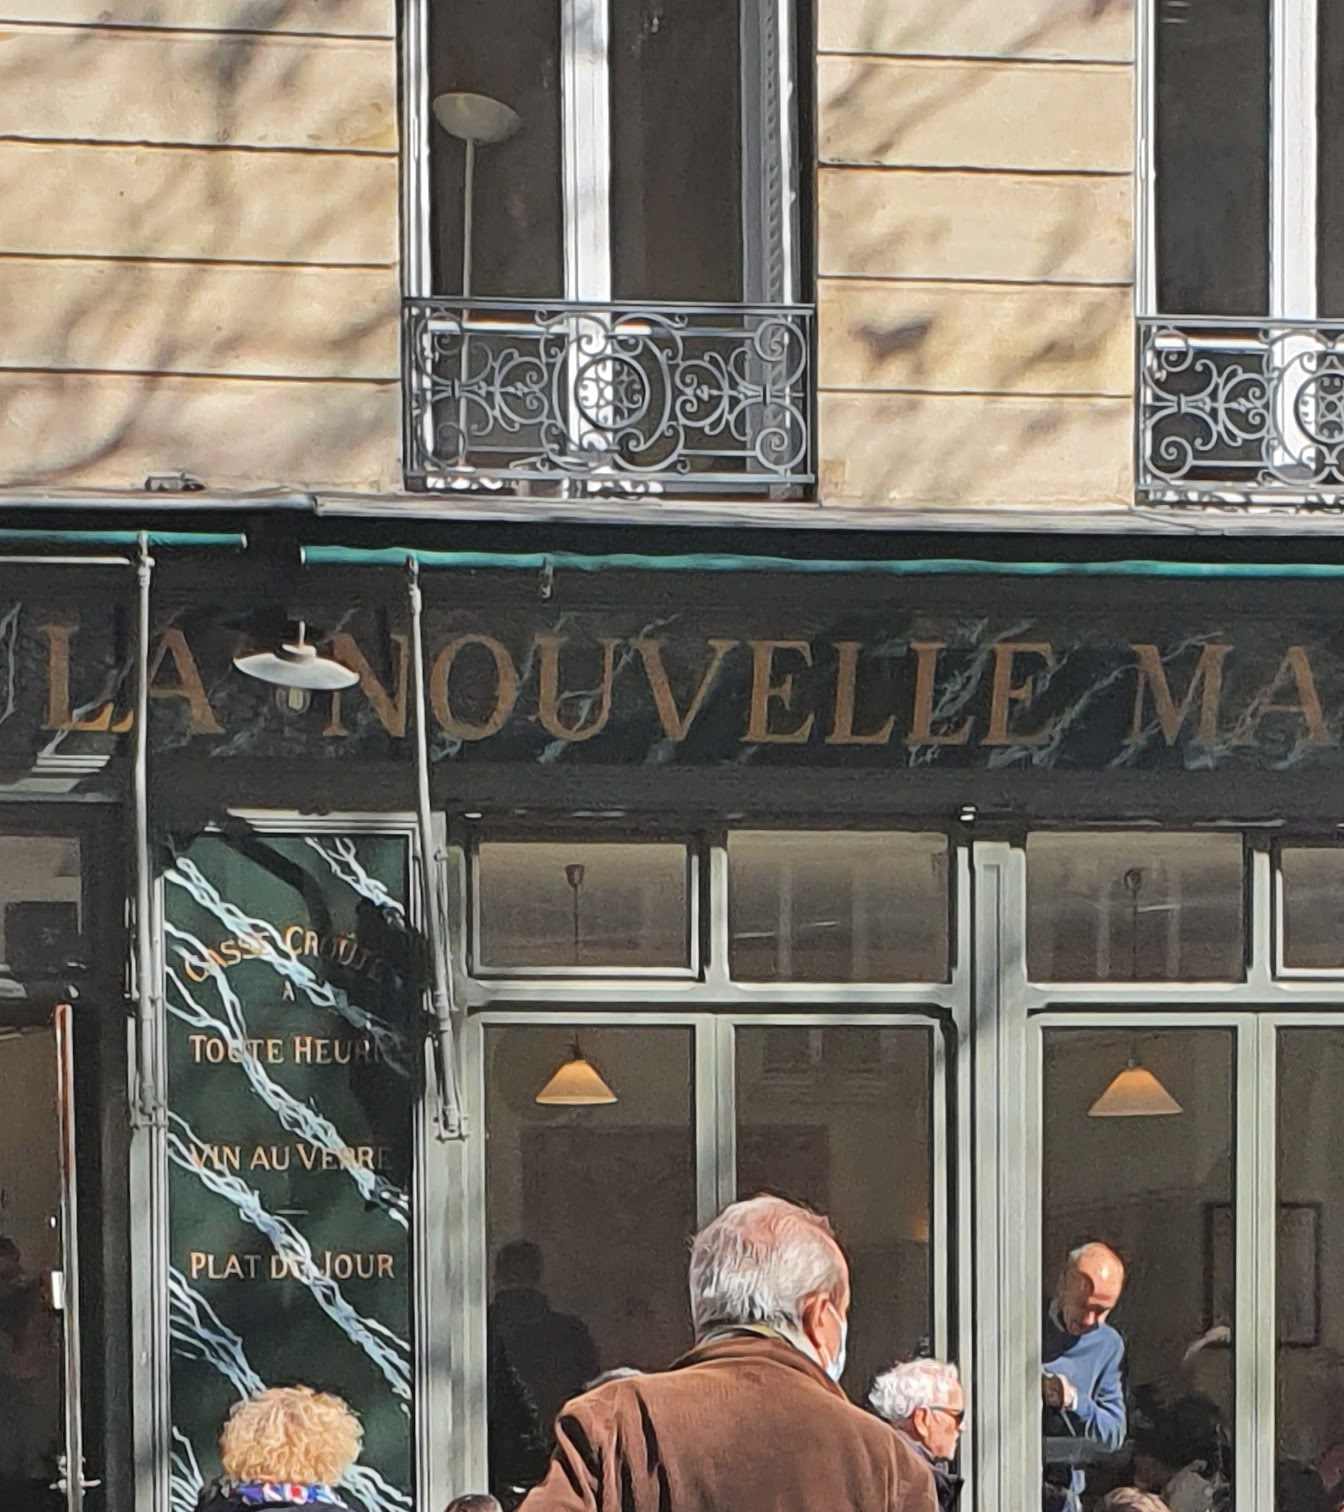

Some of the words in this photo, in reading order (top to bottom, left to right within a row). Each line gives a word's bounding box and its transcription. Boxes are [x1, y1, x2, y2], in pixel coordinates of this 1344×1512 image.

[40, 624, 226, 736] LA
[322, 631, 1058, 747] NOUVELLE
[188, 1034, 285, 1064] TOUTE
[189, 1143, 241, 1170] VIN
[249, 1143, 291, 1171] AU
[294, 1143, 393, 1171] VERRE
[189, 1251, 262, 1280] PLAT
[320, 1250, 396, 1280] JOUR
